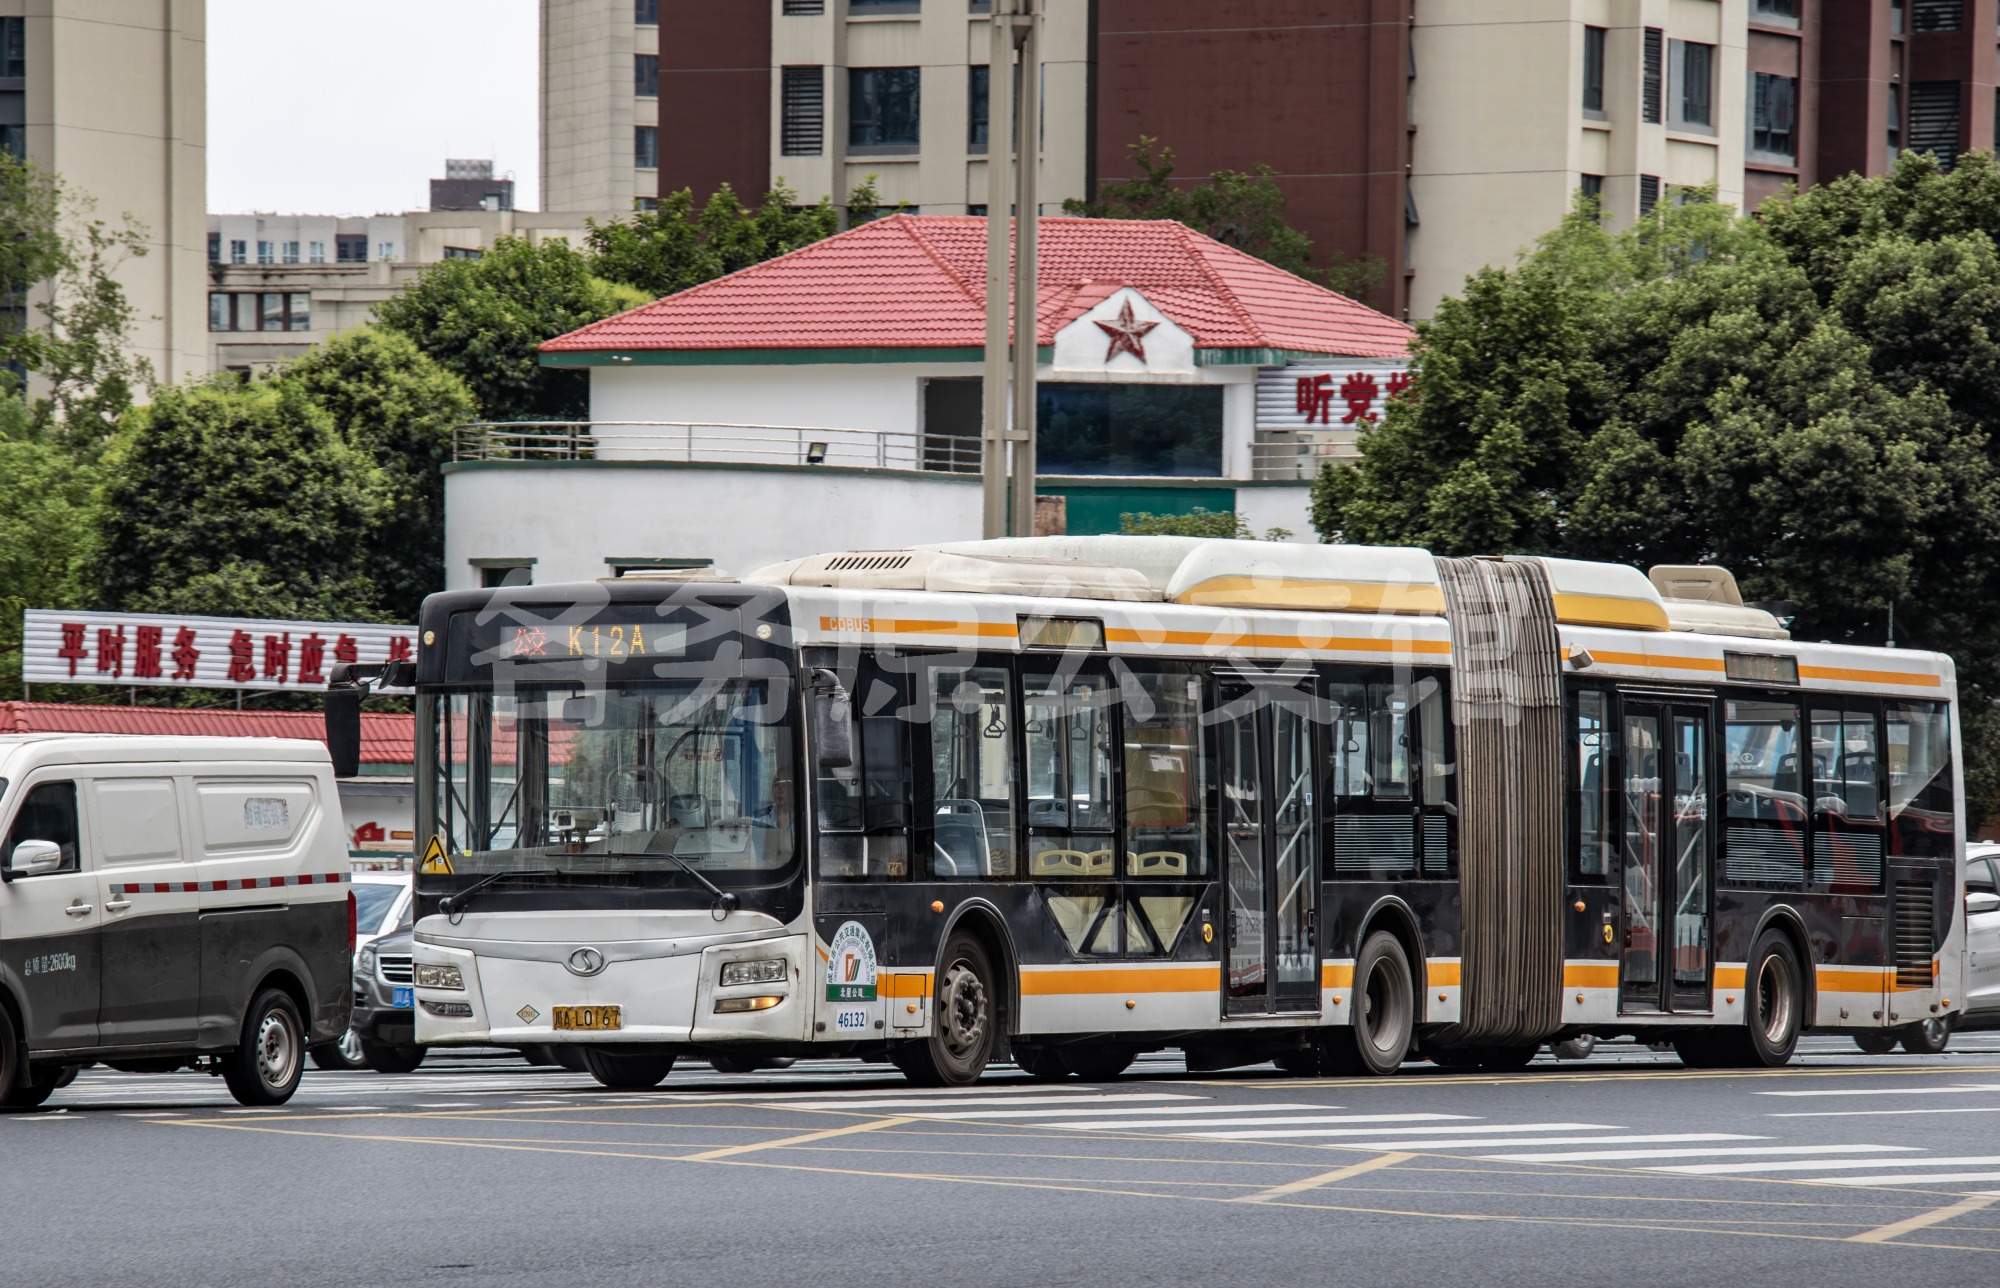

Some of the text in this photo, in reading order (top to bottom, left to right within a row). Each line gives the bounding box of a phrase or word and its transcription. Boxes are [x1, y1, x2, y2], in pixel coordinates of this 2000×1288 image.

[58, 622, 200, 681] 平时服务
[227, 628, 359, 684] 急时应急
[568, 624, 646, 657] K12A
[521, 1010, 536, 1018] CNG
[838, 1011, 865, 1028] 46132
